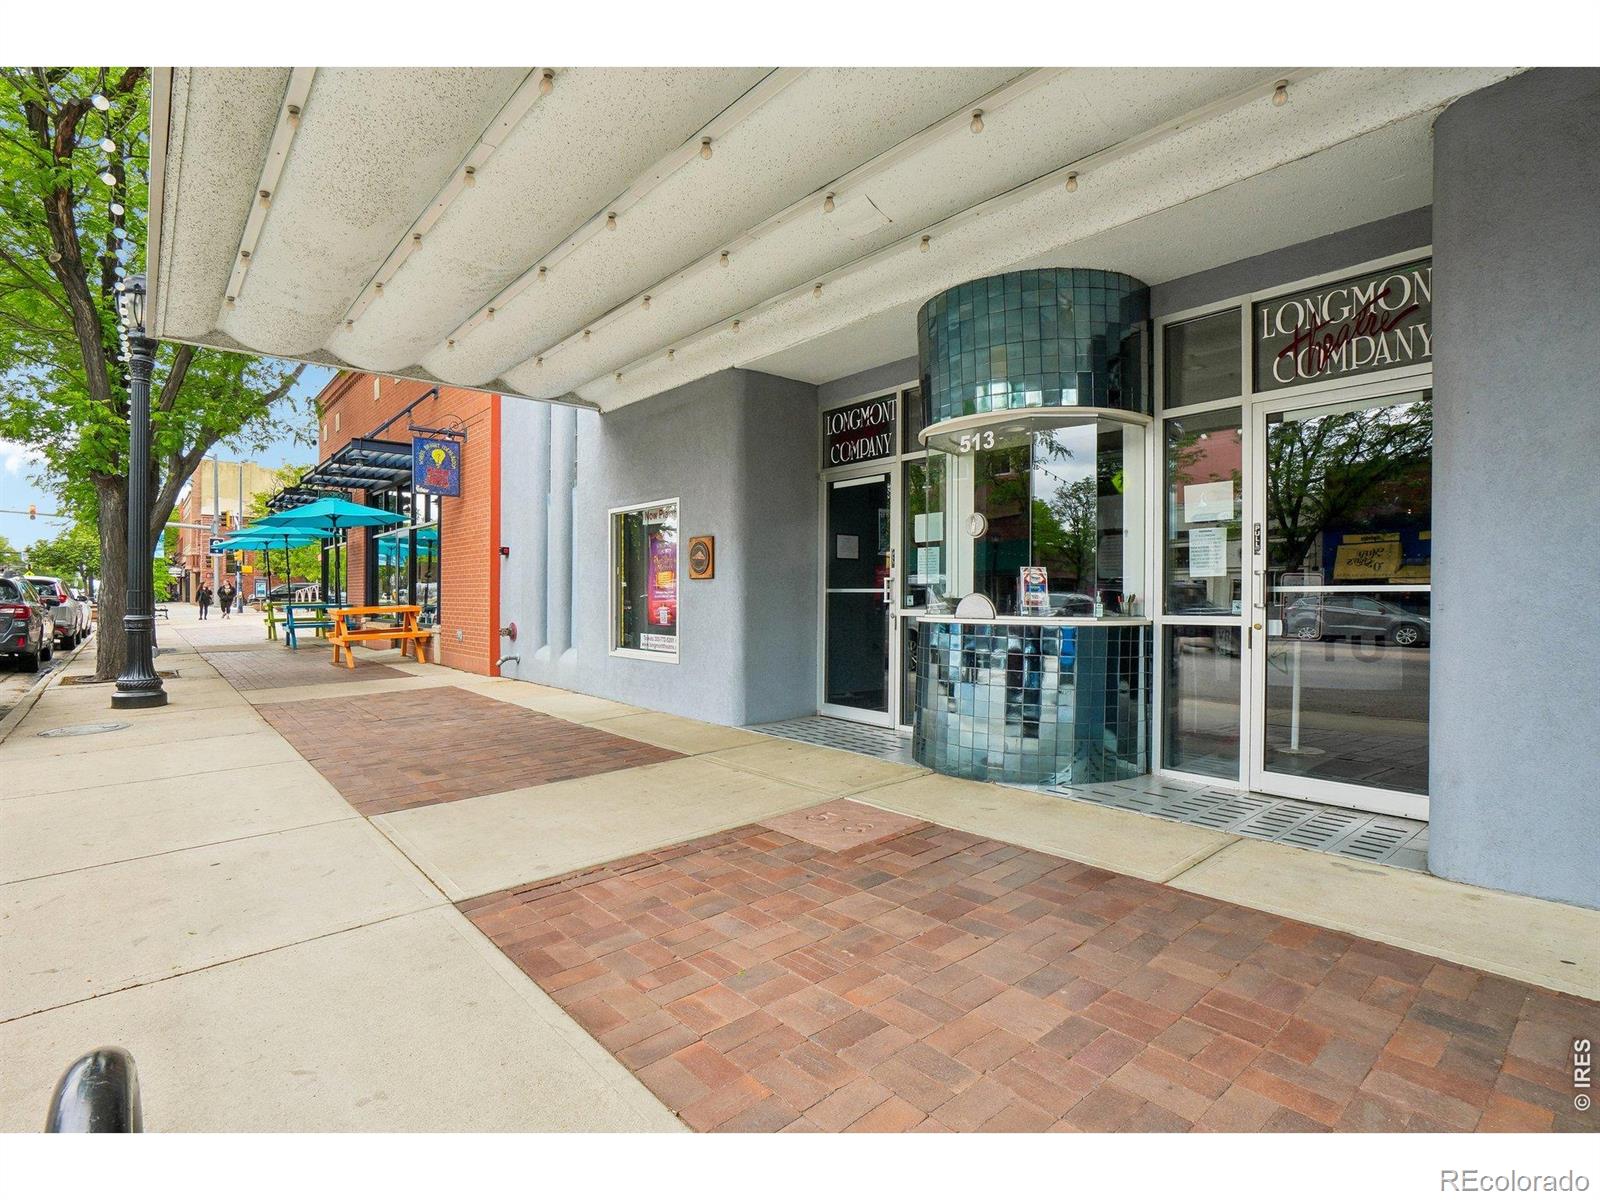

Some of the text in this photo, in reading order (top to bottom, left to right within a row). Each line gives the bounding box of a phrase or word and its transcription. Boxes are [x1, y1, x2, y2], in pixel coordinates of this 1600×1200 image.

[1262, 268, 1433, 339] LONGMON
[1273, 323, 1433, 383] COMPANY
[827, 399, 897, 436] LONGMONT
[831, 432, 892, 464] COMPANY
[960, 430, 995, 453] 513
